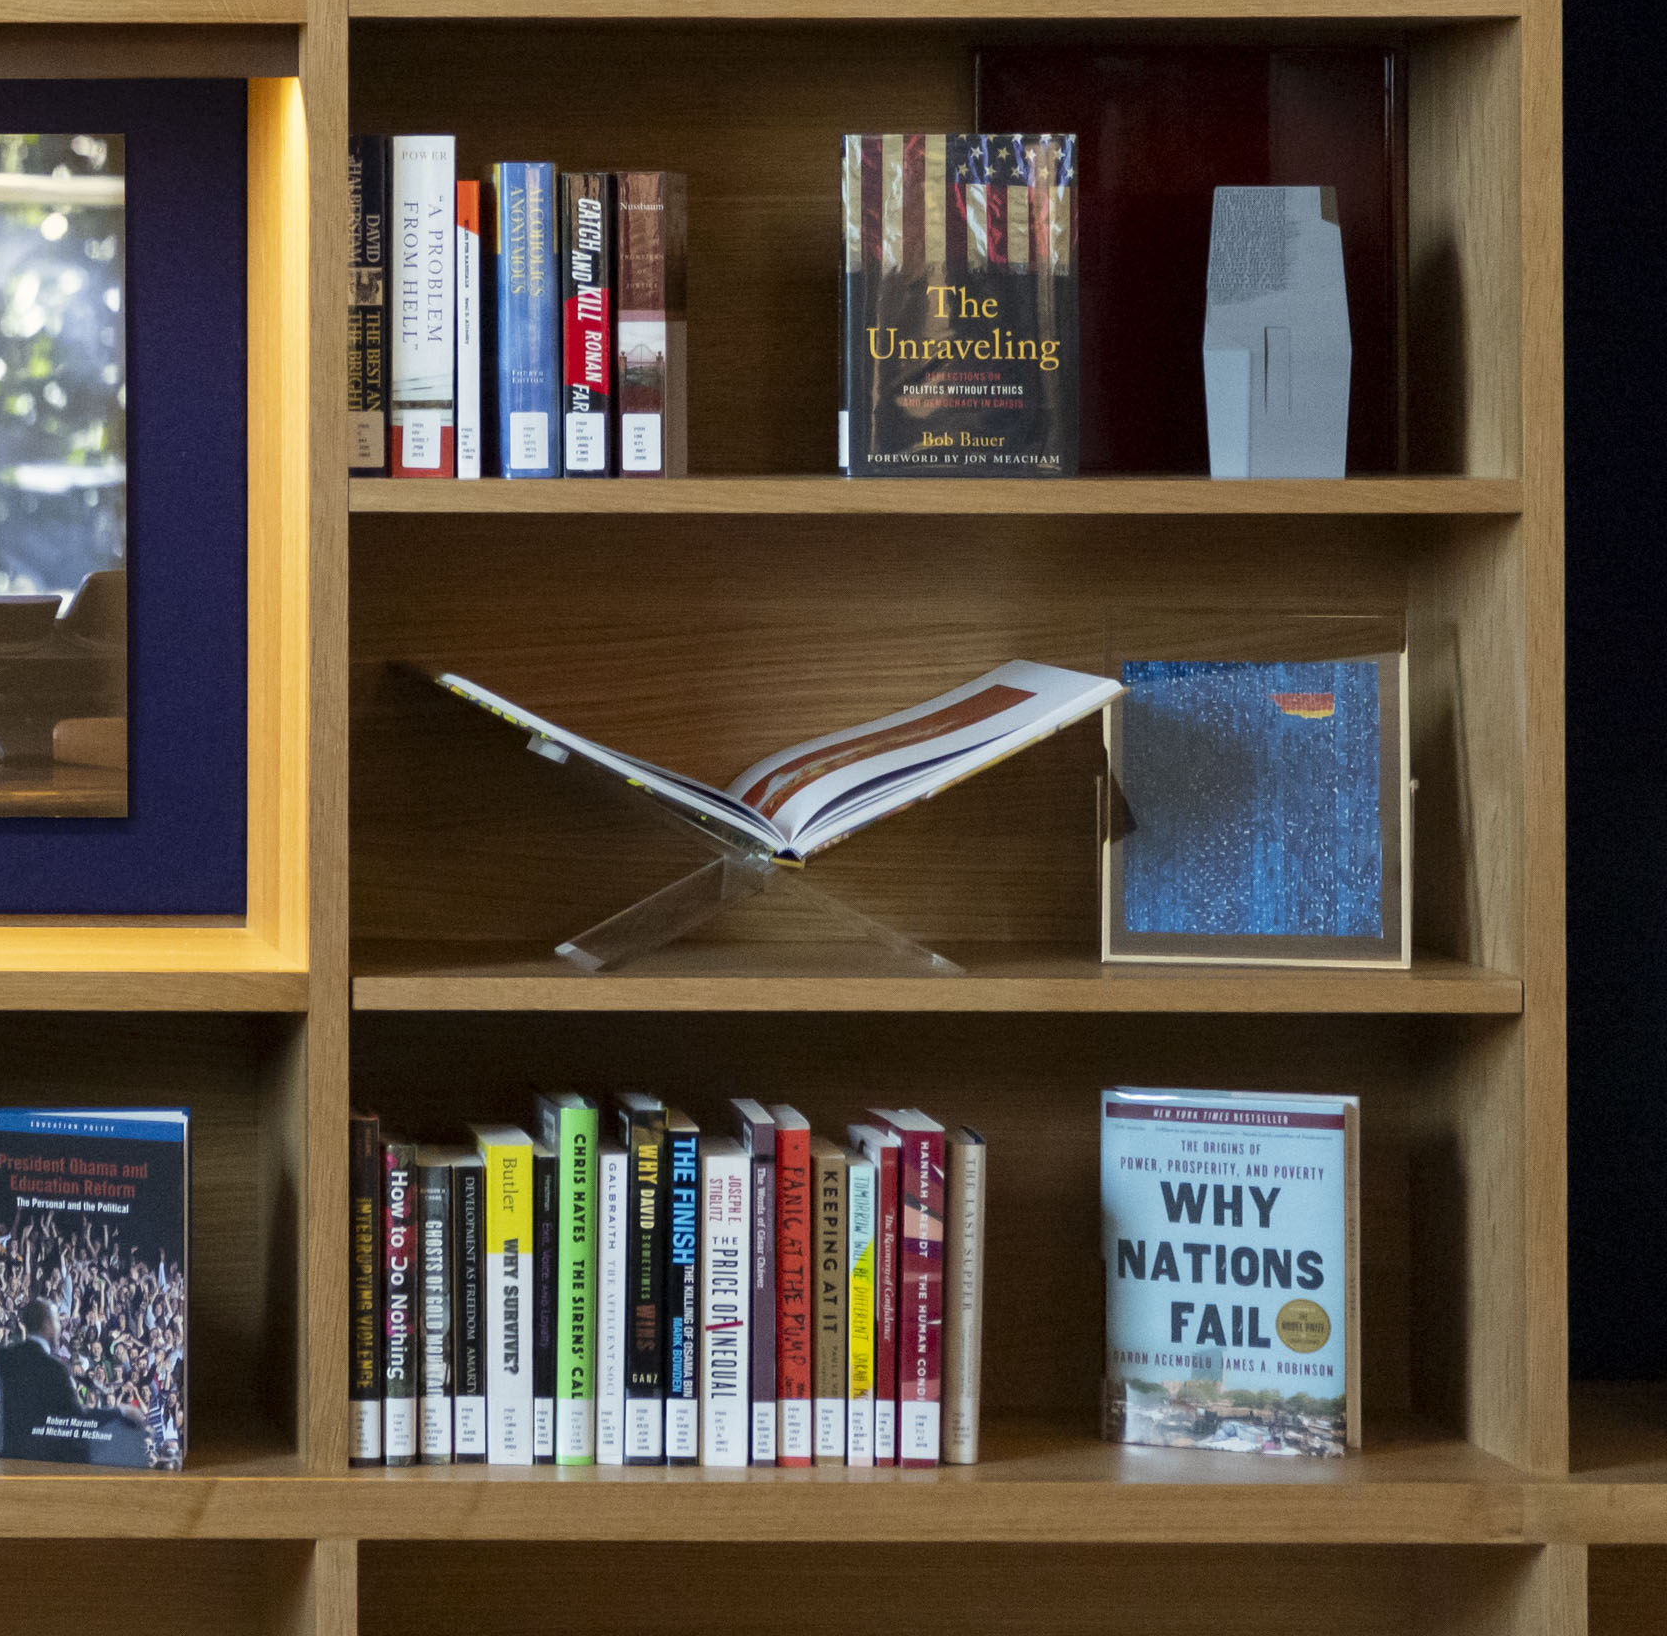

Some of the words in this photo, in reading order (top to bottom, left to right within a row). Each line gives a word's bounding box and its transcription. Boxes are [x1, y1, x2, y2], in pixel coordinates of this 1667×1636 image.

[578, 198, 601, 252] CATCH
[572, 250, 591, 281] AND
[578, 282, 601, 321] KILL
[927, 286, 998, 318] The
[867, 328, 1059, 370] Unraveling
[923, 432, 953, 447] Bob
[960, 432, 1005, 447] Bauer
[574, 1134, 586, 1185] CHRIS
[674, 1137, 696, 1181] THE
[920, 1142, 929, 1199] HANNAH
[391, 1171, 408, 1219] How
[573, 1189, 586, 1244] HAYES
[1160, 1181, 1281, 1228] WHY
[673, 1188, 695, 1264] FINISH
[823, 1171, 838, 1272] KEEPING
[919, 1204, 928, 1258] ARENDT
[1118, 1239, 1324, 1290] NATIONS
[824, 1282, 837, 1306] AT
[387, 1294, 408, 1380] Nothing
[824, 1313, 837, 1333] IT
[1170, 1301, 1271, 1348] FAIL
